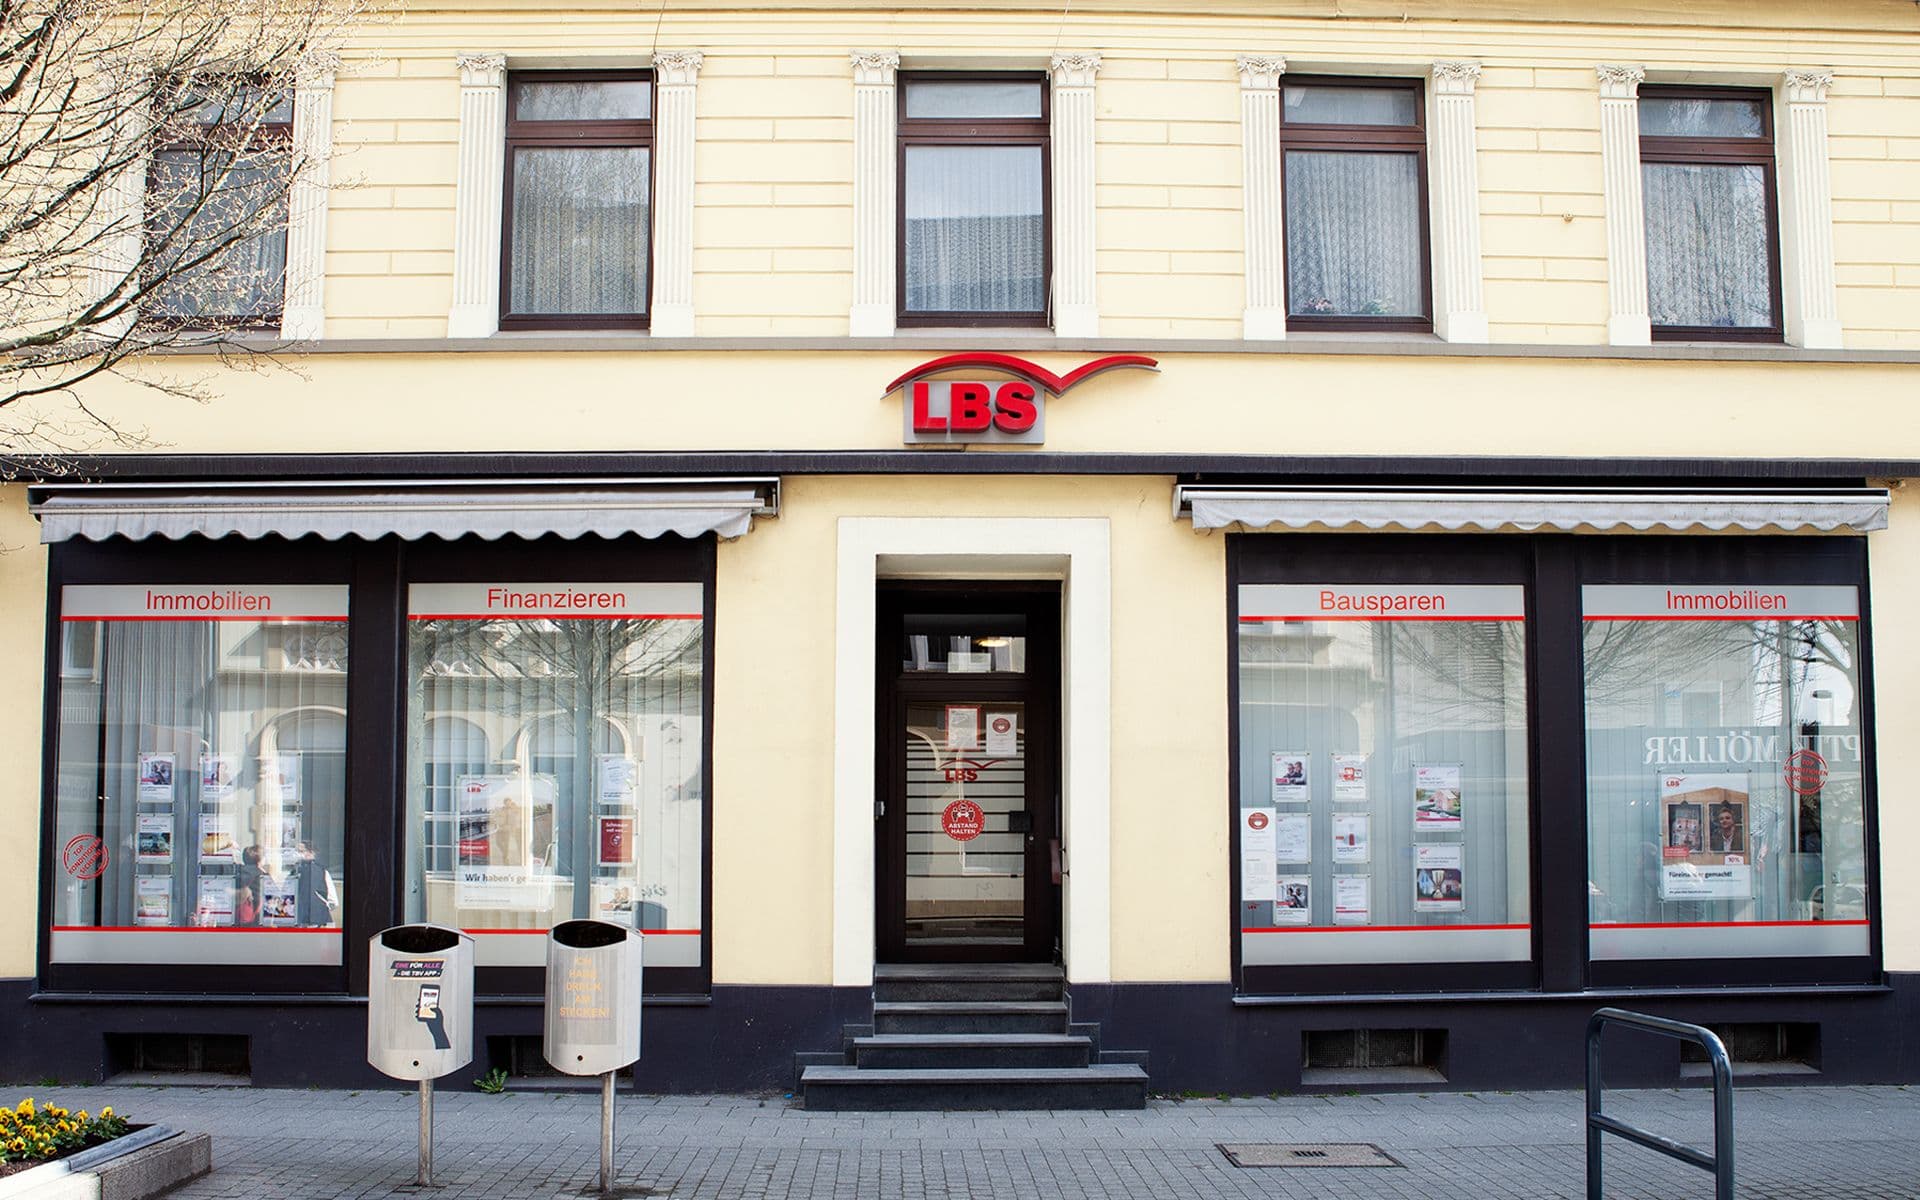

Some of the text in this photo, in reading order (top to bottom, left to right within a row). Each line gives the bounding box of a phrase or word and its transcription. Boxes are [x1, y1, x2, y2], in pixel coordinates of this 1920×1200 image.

[913, 382, 1038, 434] LBS
[147, 591, 271, 611] Immobilien
[487, 588, 626, 609] Finanzieren
[1319, 590, 1446, 615] Bausparen
[1667, 590, 1787, 610] Immobilien
[945, 768, 978, 782] LBS
[68, 837, 102, 875] KONDITIONEN
[73, 844, 84, 856] TOP
[464, 873, 480, 882] Wir
[481, 873, 515, 882] haben's
[1705, 871, 1732, 879] gemacht!
